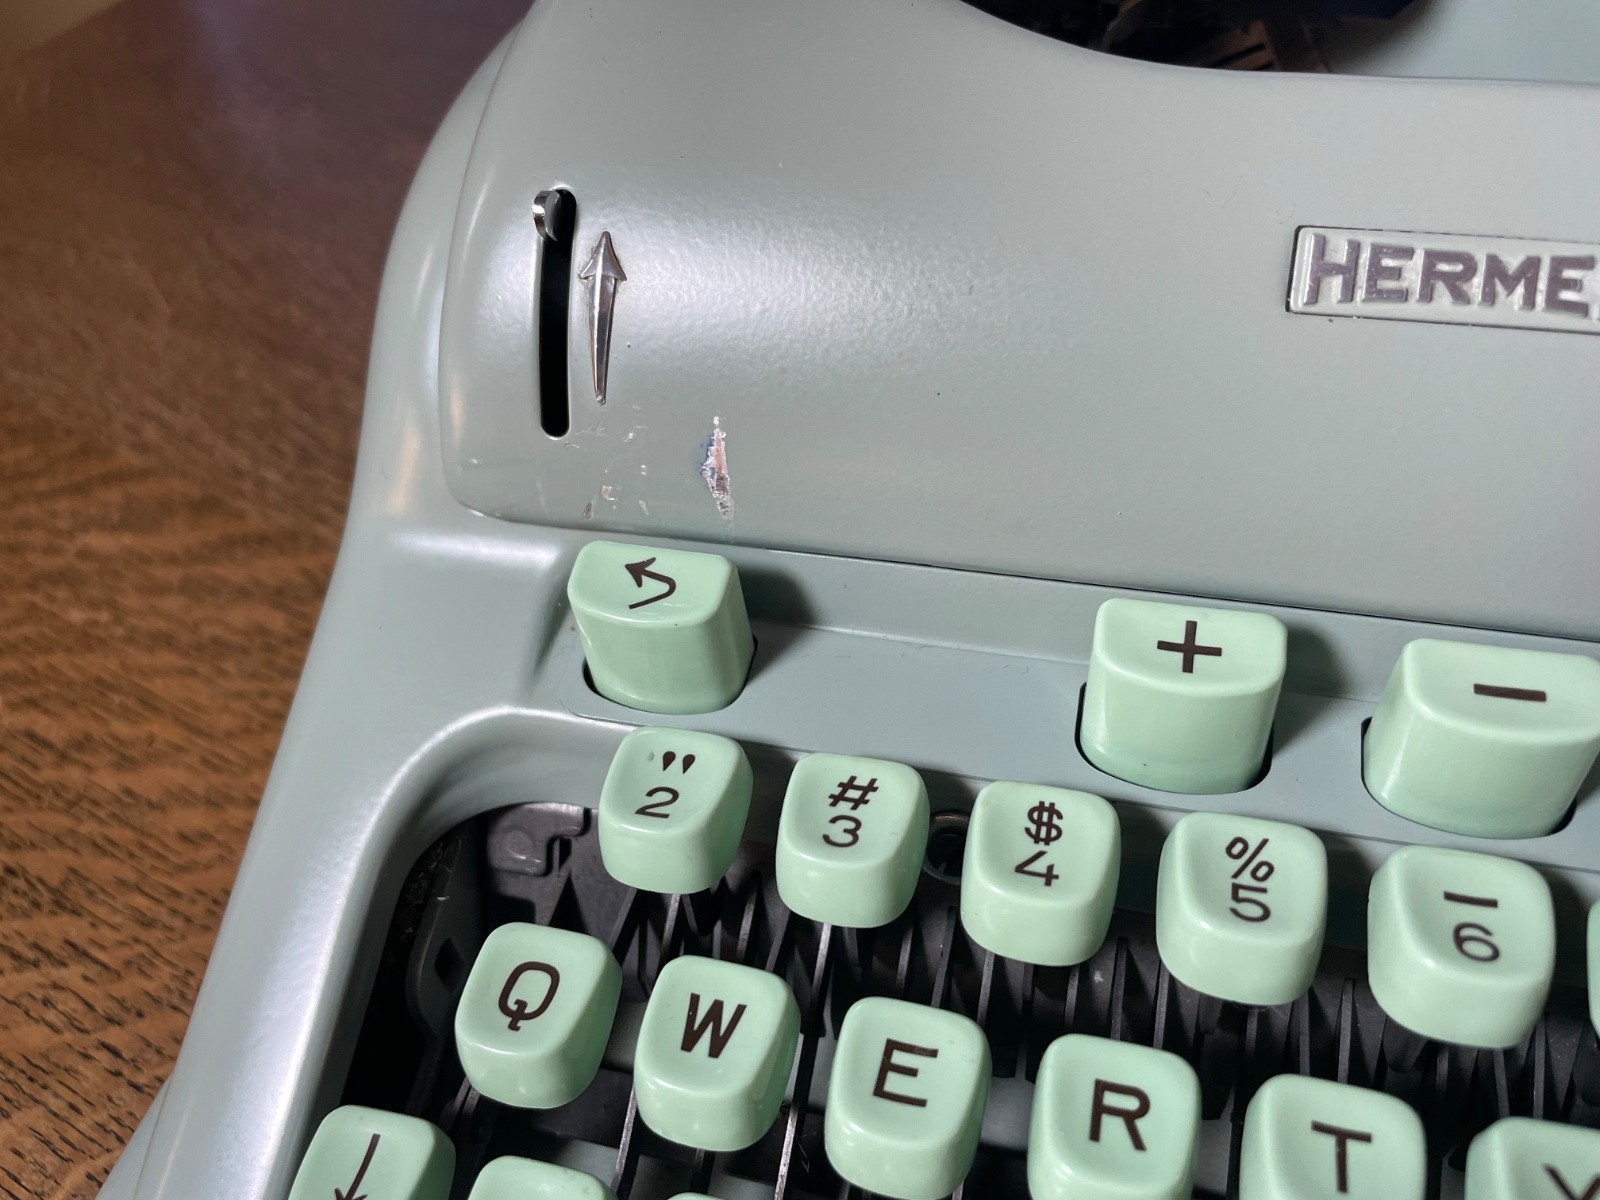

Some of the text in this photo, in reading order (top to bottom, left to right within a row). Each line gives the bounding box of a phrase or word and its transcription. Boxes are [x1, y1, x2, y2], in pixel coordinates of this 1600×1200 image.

[1303, 233, 1600, 318] HERME
[635, 787, 679, 818] 2
[829, 776, 878, 810] #
[823, 815, 861, 847] 3
[1025, 801, 1063, 846] $
[1015, 851, 1059, 886] 4
[1226, 837, 1274, 882] %
[1230, 883, 1270, 922] 5
[1453, 923, 1500, 962] 6
[498, 962, 560, 1031] Q
[681, 993, 746, 1058] W
[873, 1039, 938, 1107] E
[1089, 1079, 1150, 1151] R
[1311, 1121, 1372, 1194] T
